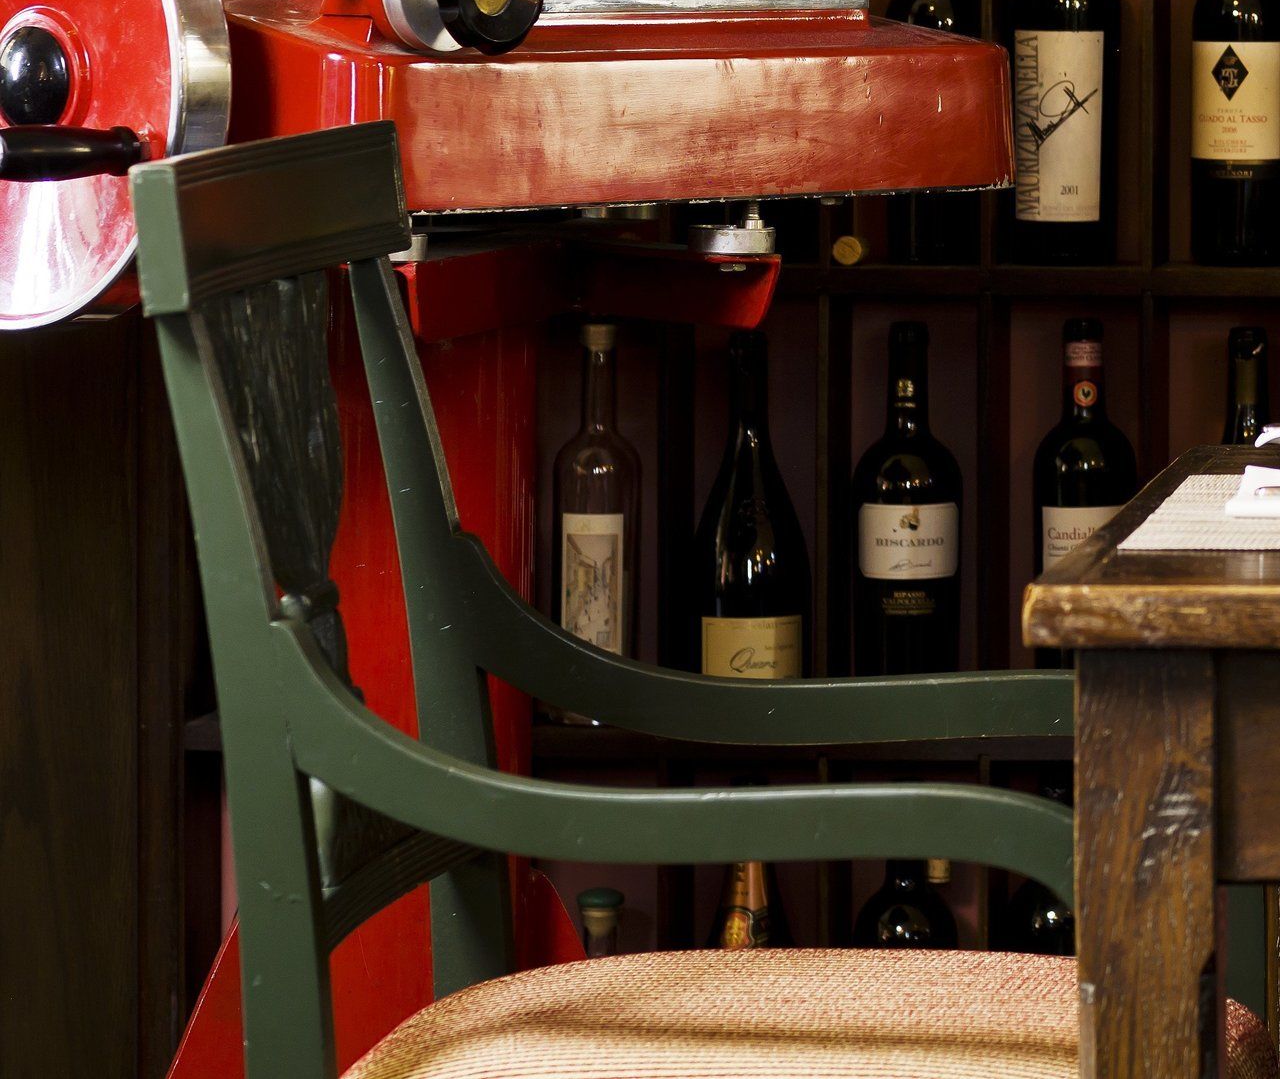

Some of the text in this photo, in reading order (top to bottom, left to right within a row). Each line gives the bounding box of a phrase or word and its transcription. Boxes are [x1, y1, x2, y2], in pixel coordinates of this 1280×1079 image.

[1016, 35, 1040, 122] ZANELLA
[1224, 114, 1238, 124] AL
[1239, 114, 1268, 124] TASSO
[1060, 185, 1079, 196] 2001
[875, 536, 945, 548] BISCARDO
